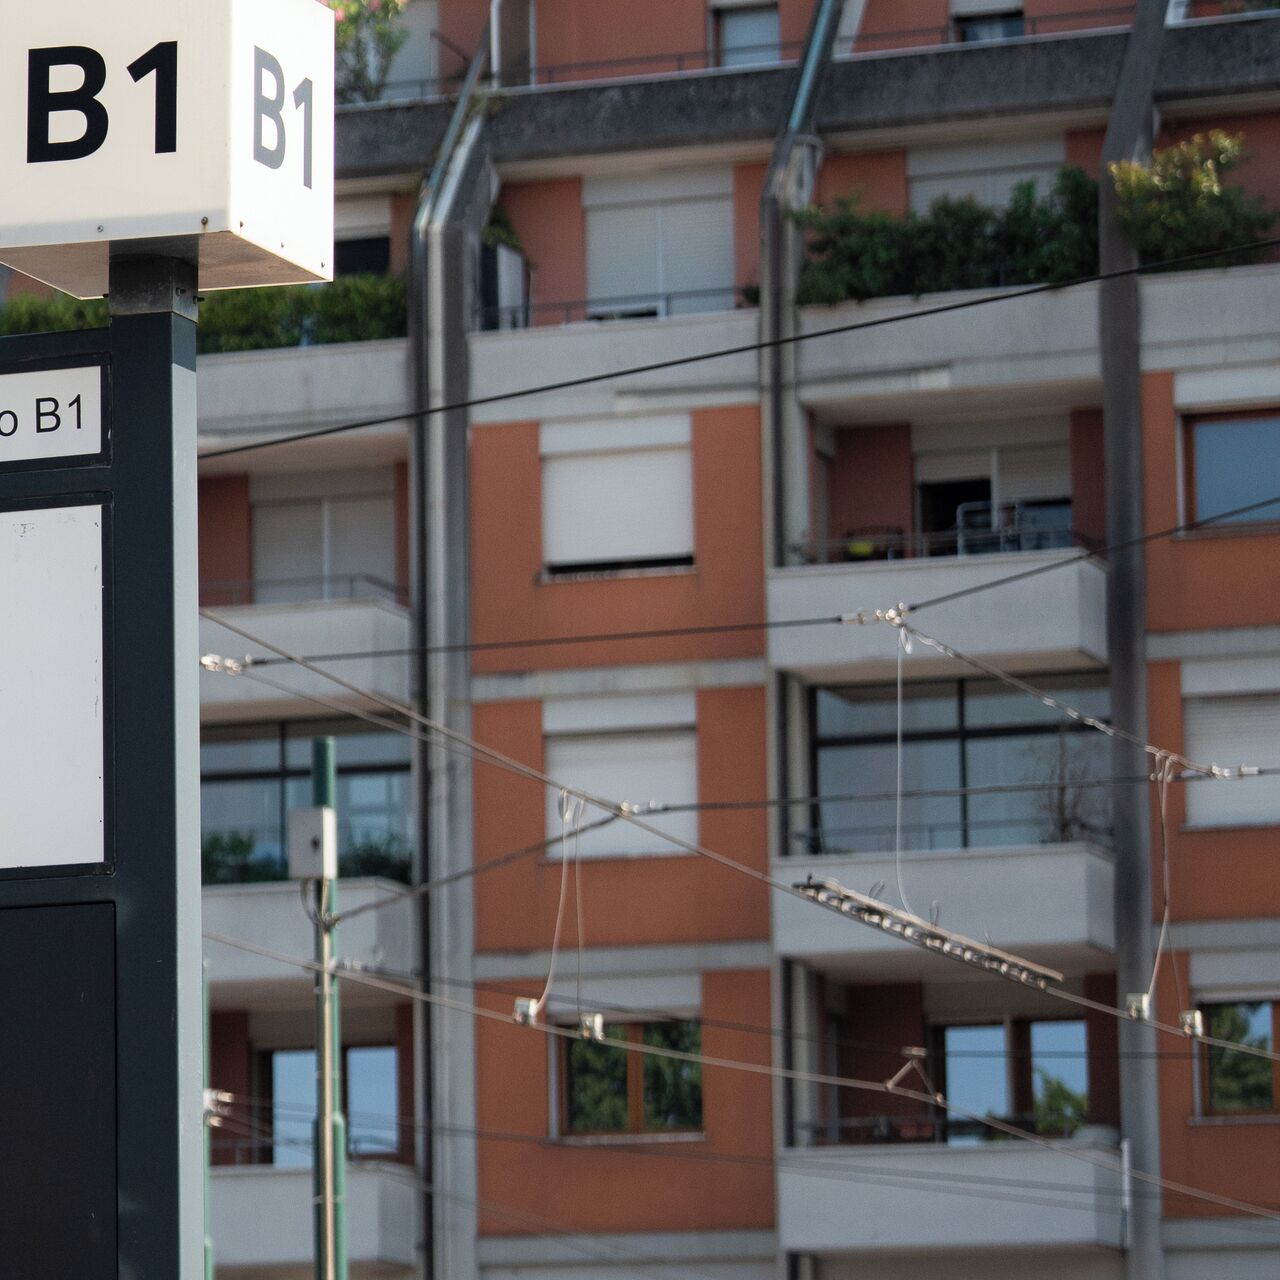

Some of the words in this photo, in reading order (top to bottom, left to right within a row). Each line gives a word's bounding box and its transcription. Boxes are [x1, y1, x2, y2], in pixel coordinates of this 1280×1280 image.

[27, 41, 178, 163] B1
[253, 45, 313, 190] B1
[35, 393, 82, 433] B1
